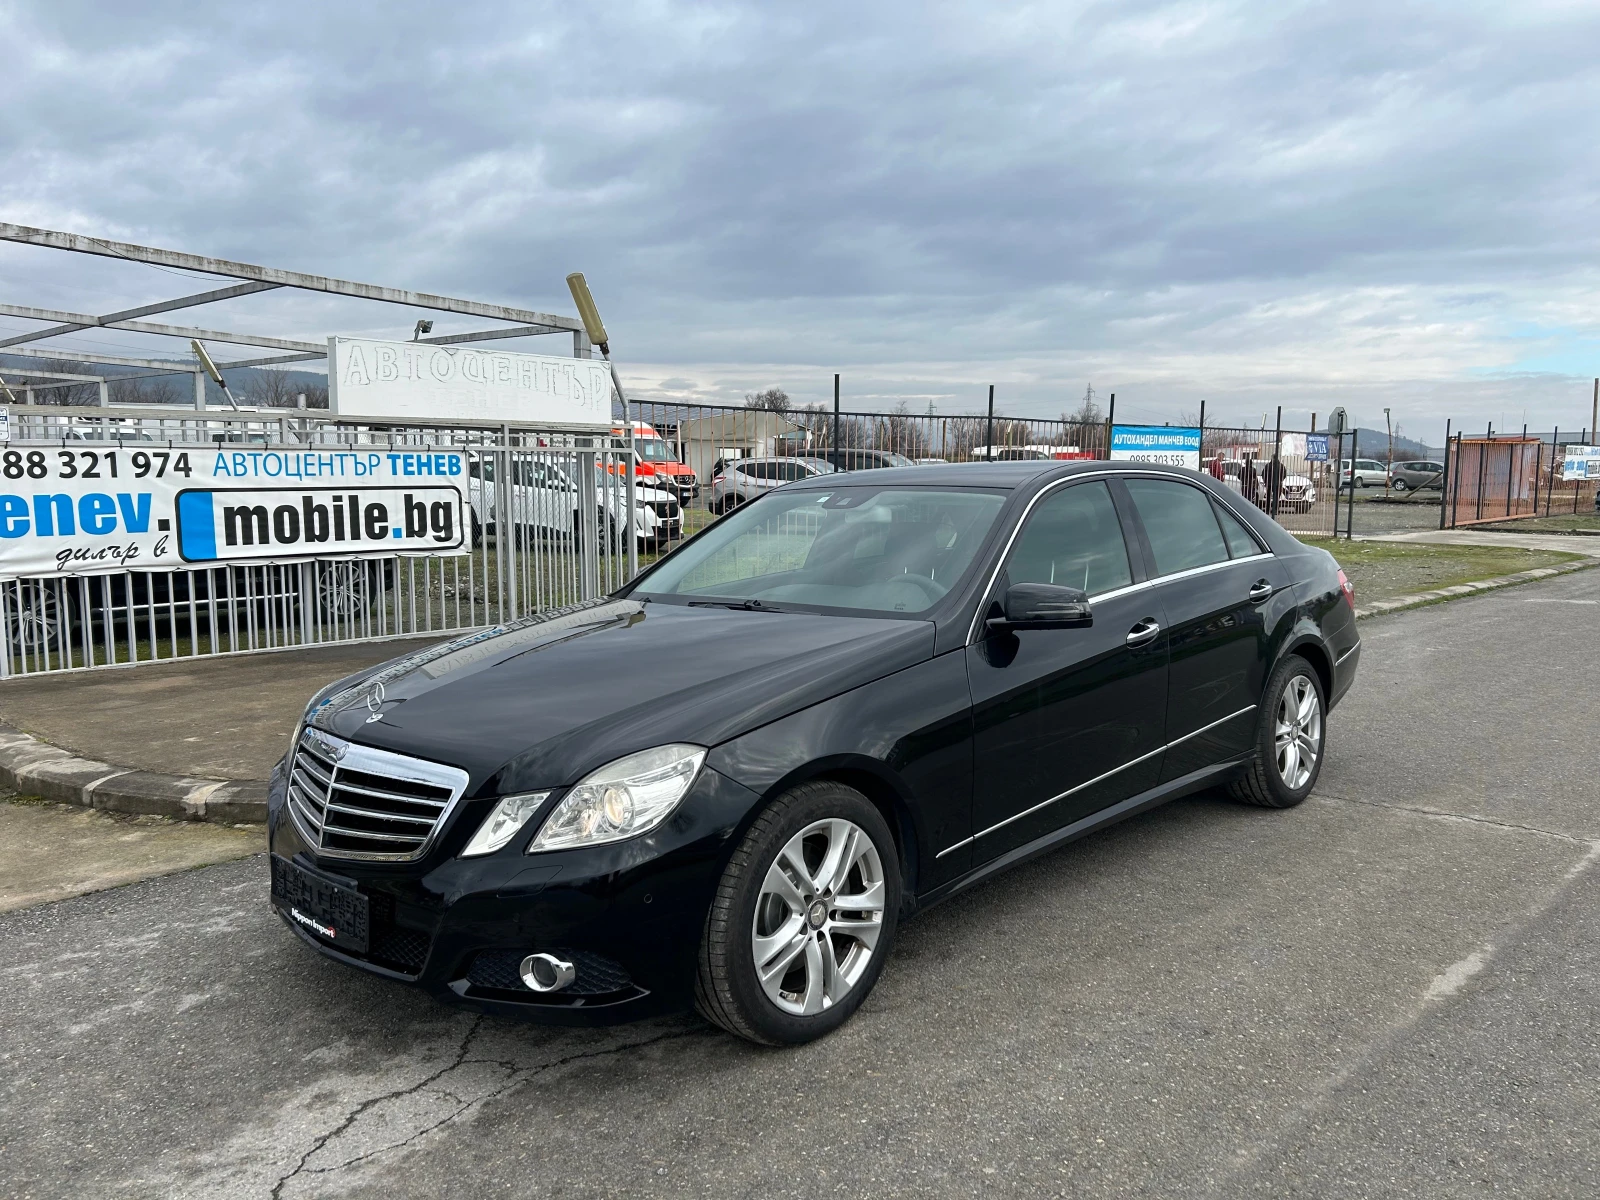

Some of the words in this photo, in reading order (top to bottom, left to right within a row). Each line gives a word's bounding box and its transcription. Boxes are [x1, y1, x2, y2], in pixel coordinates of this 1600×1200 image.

[344, 345, 609, 413] АВТОЦЕНТЪР
[1114, 434, 1158, 447] АУТОХАНДЕЛ
[1159, 435, 1184, 446] МАНЧЕВ
[1184, 437, 1199, 448] ЕООД
[0, 451, 48, 479] 88
[57, 451, 118, 478] 321
[131, 452, 192, 478] 974
[213, 453, 381, 481] АВТОЦЕНТЪР
[386, 454, 462, 476] ТЕНЕВ
[1171, 455, 1185, 466] 555
[223, 494, 453, 543] mobile.bg
[56, 542, 140, 570] дилър
[153, 534, 169, 557] в
[291, 908, 313, 927] Nippon
[313, 919, 335, 938] Import
